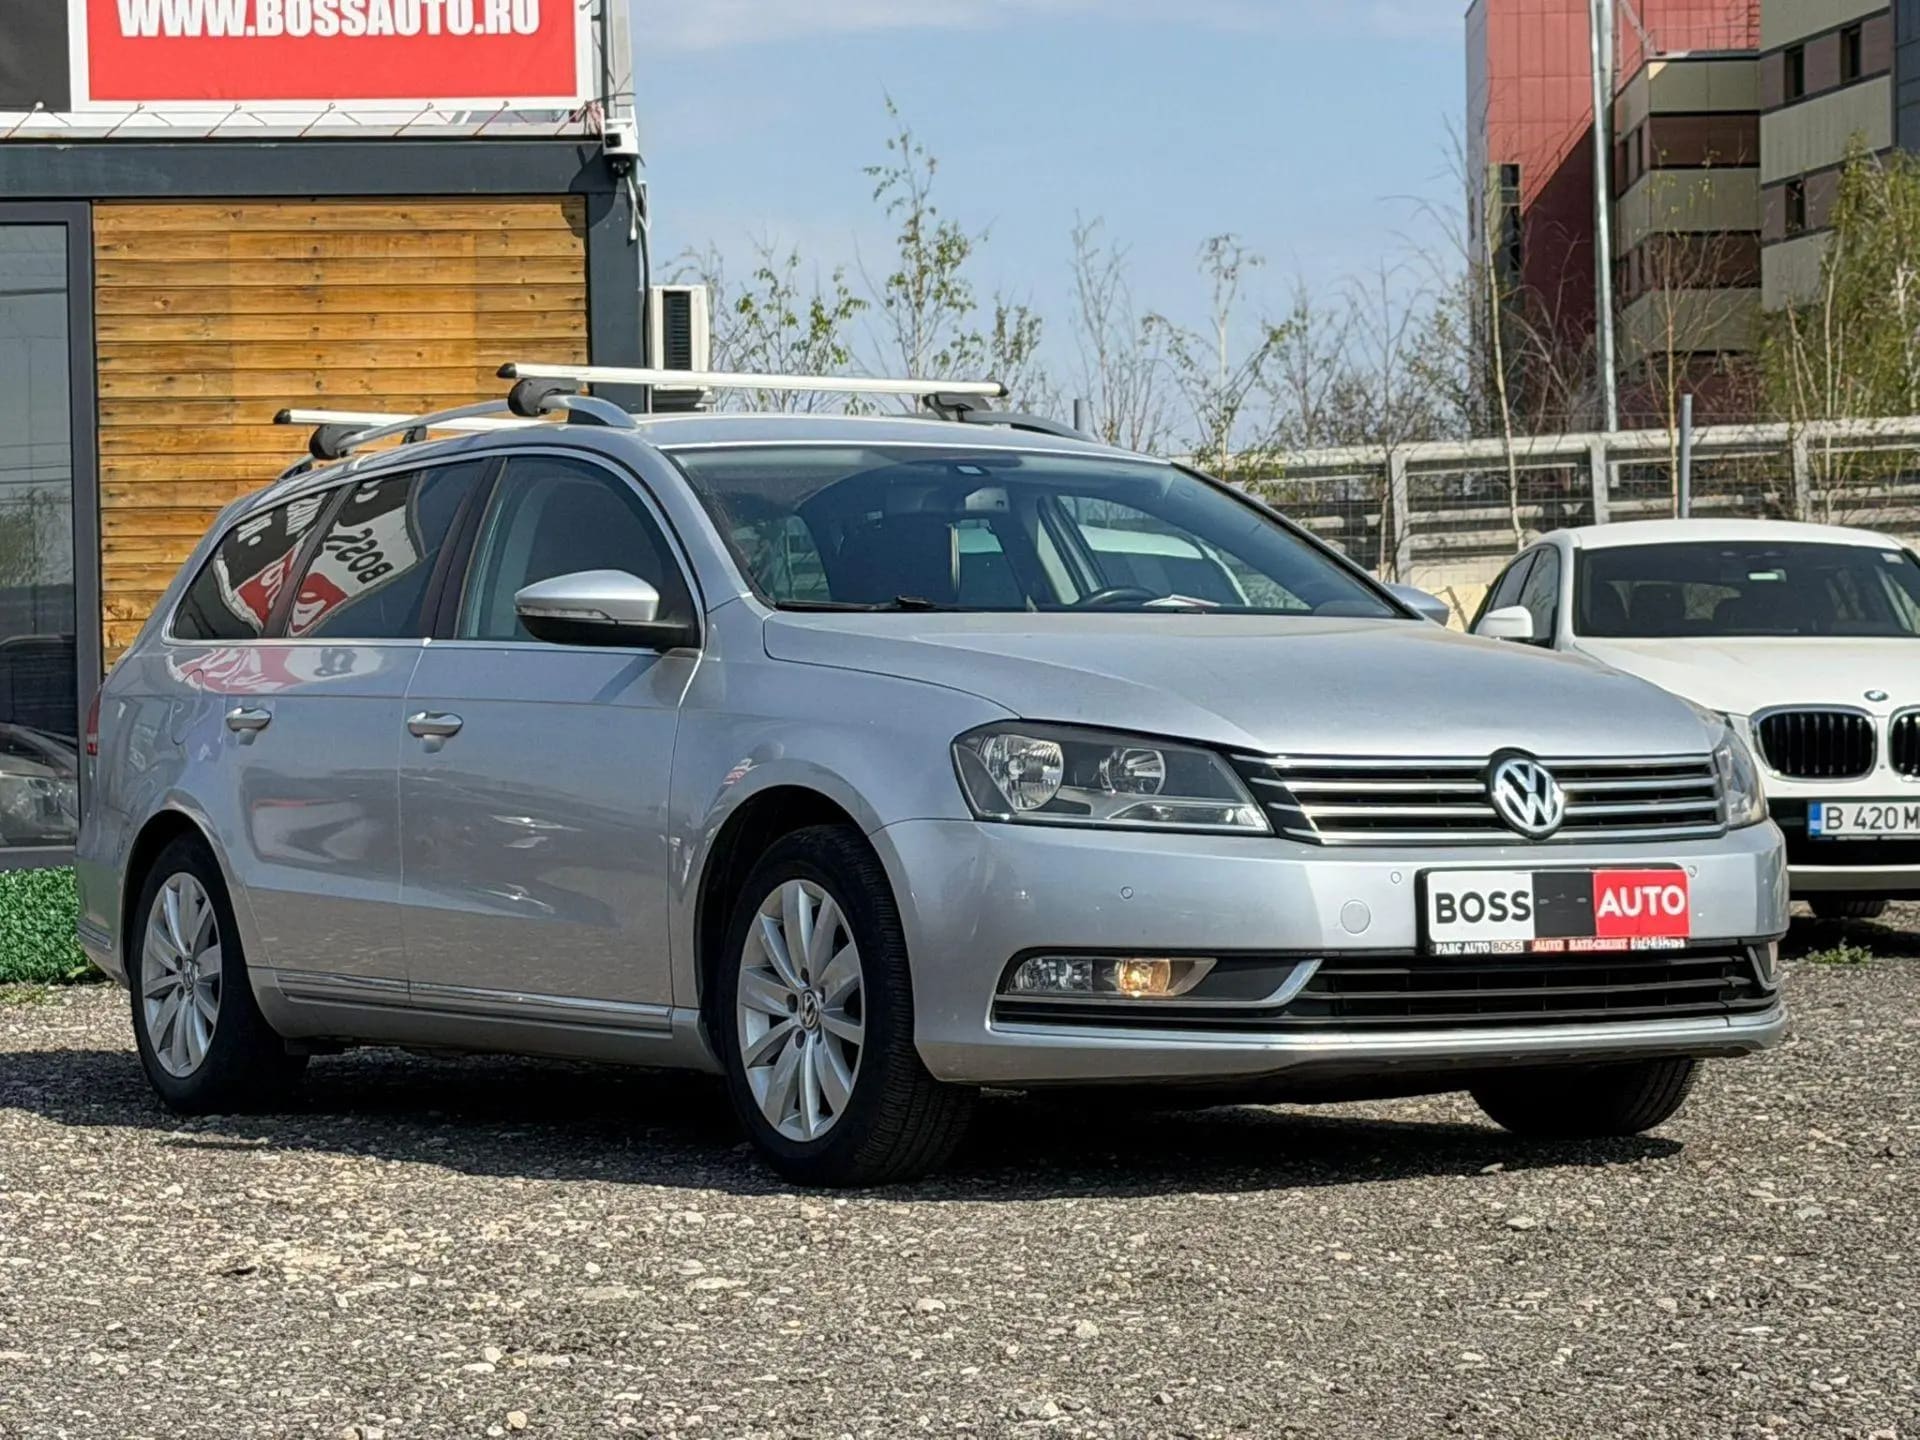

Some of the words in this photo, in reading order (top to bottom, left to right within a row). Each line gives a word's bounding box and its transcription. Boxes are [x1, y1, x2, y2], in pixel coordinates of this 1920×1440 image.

[117, 0, 540, 37] WWW.BOSSAUTO.RU
[1826, 806, 1844, 830] B
[1853, 806, 1898, 830] 420
[1903, 806, 1920, 830] M
[1435, 890, 1531, 924] BOSS
[1597, 885, 1686, 917] AUTO
[1463, 942, 1490, 953] AUTO
[1493, 940, 1522, 952] BOSS
